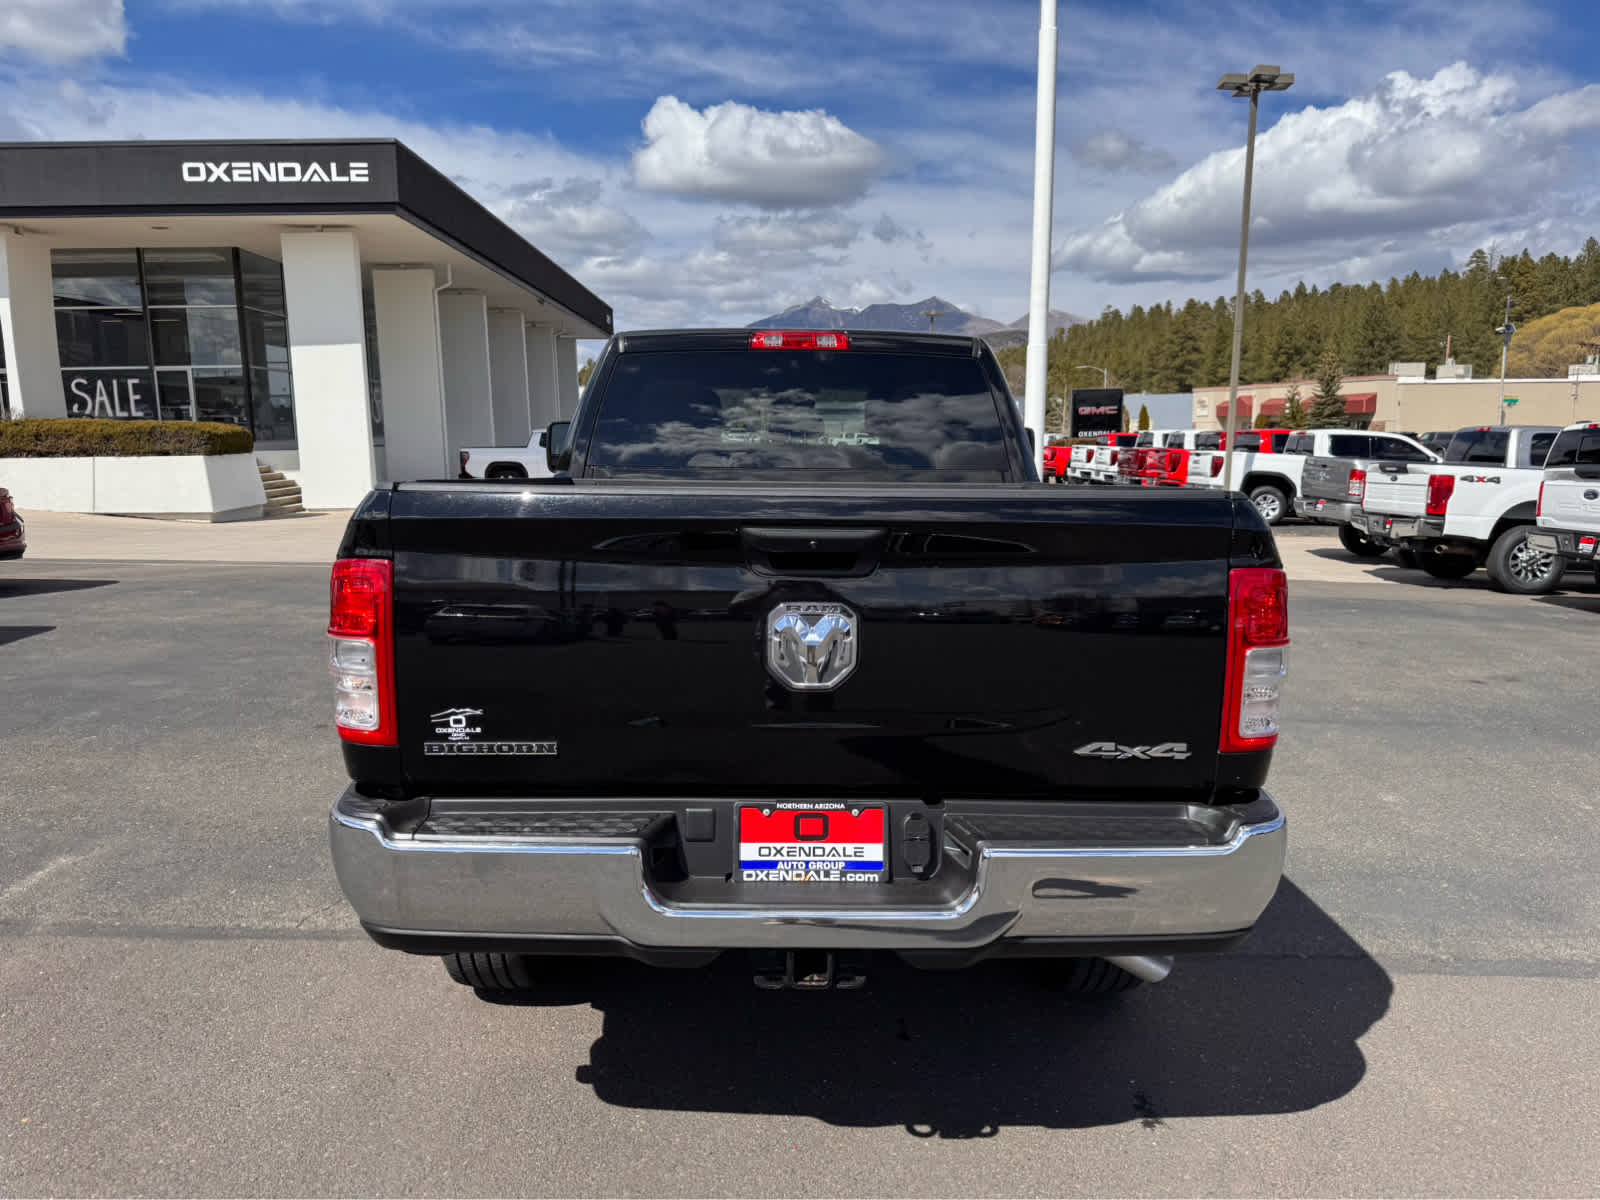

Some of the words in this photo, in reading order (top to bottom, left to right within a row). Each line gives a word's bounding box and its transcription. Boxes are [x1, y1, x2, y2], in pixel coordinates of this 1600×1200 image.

[181, 161, 370, 182] OXENDALE
[70, 378, 145, 417] SALE
[1079, 406, 1118, 415] GMC
[786, 605, 842, 613] RAM
[424, 742, 558, 755] BIGHORN
[758, 846, 865, 857] OXENDALE
[777, 861, 806, 870] AUTO
[808, 861, 846, 870] GROUP
[743, 870, 879, 882] OXENDALE.com
